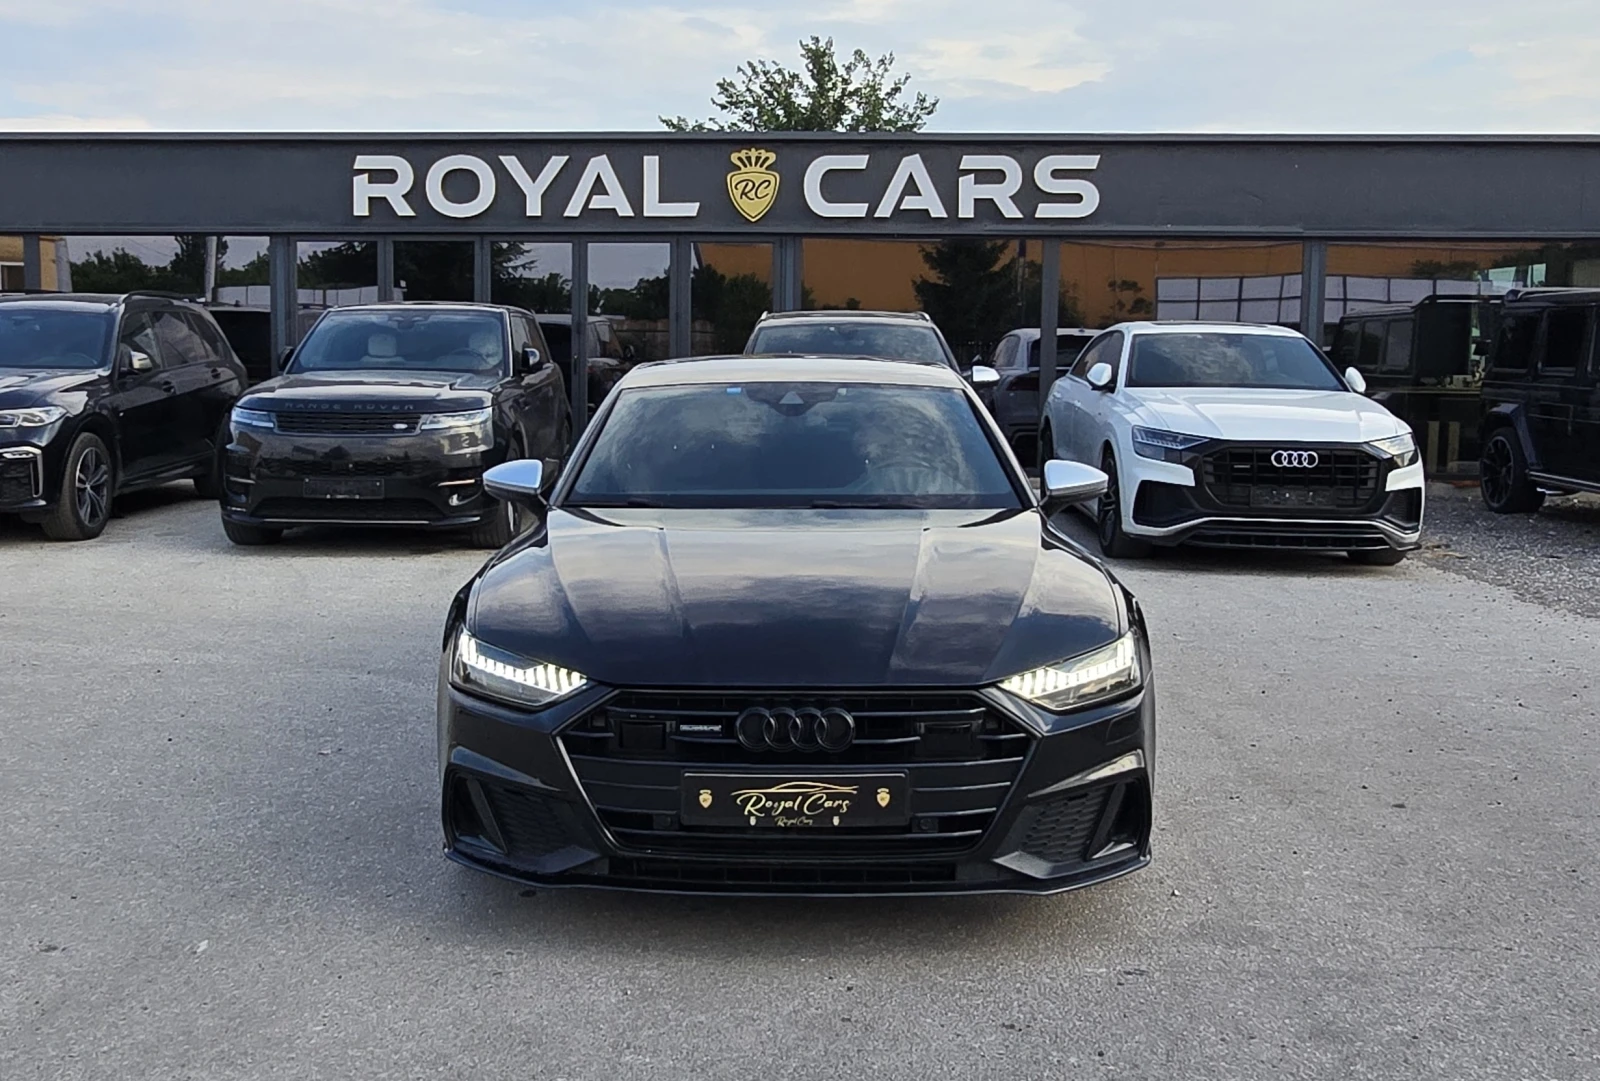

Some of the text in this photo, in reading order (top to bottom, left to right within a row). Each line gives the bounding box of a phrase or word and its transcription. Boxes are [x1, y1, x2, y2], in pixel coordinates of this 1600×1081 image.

[353, 153, 1101, 218] ROYAL CARS
[734, 178, 771, 200] RC
[736, 793, 850, 817] Royal Cars
